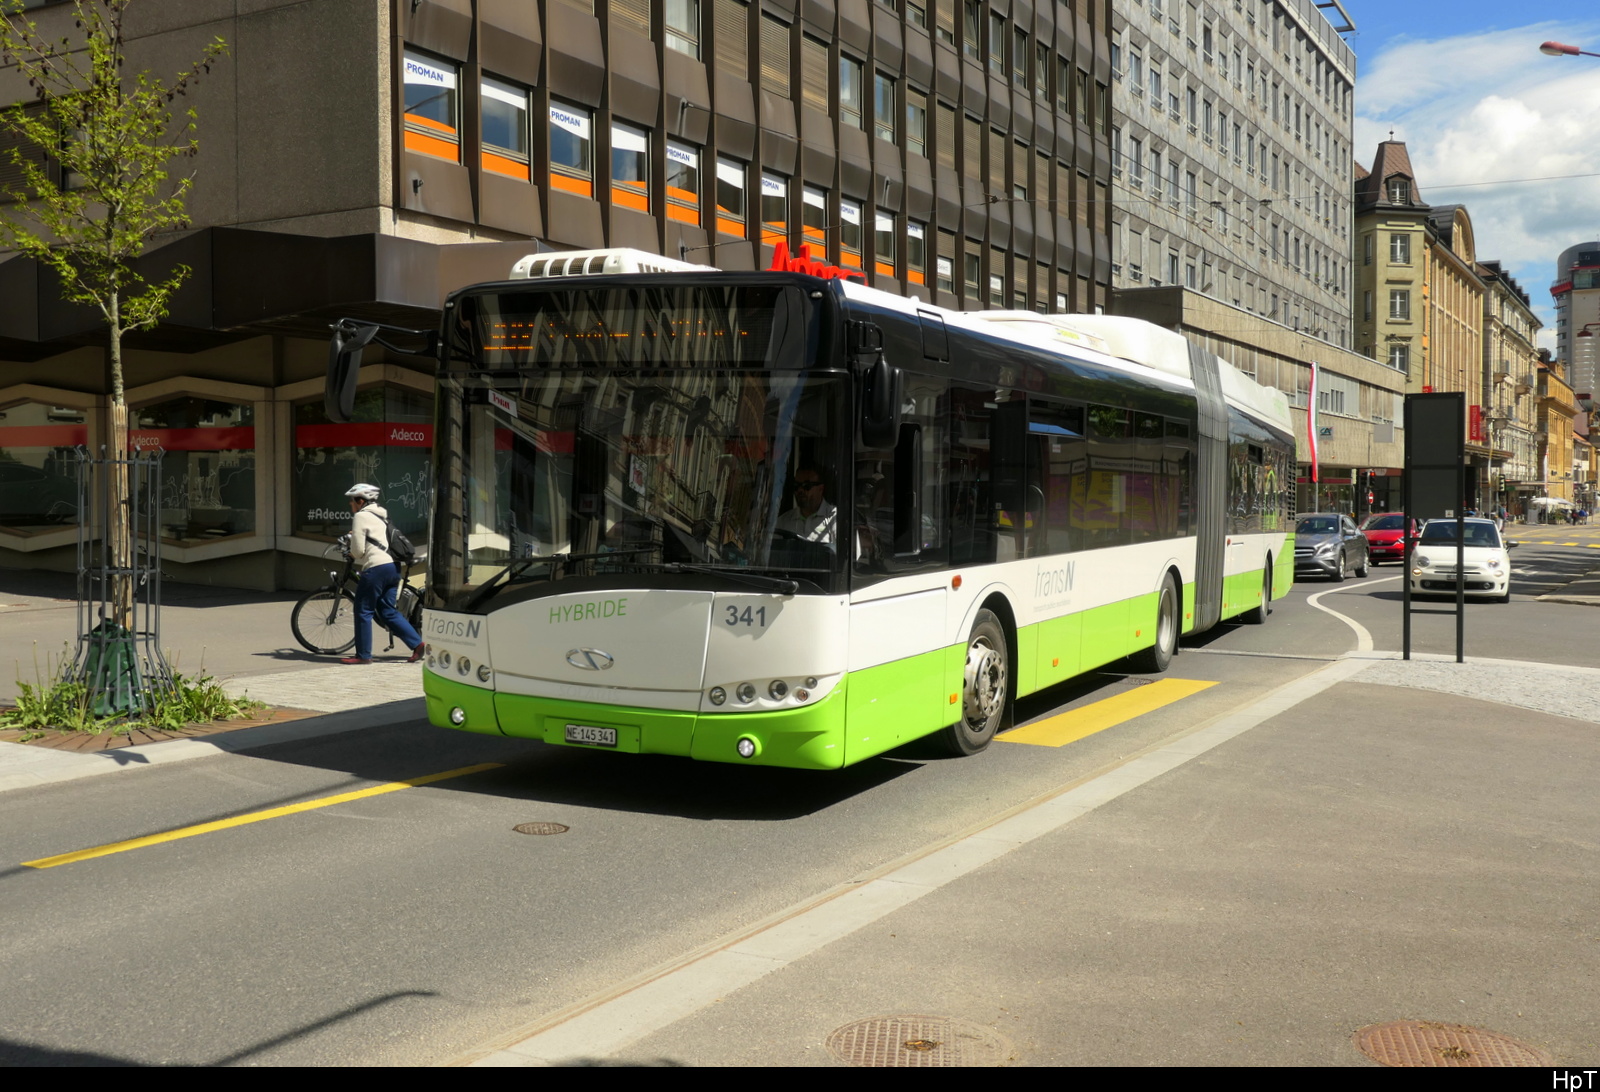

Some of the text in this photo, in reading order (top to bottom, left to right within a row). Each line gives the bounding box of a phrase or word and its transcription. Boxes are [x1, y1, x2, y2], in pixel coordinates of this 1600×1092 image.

[407, 62, 444, 82] PROMAN
[551, 111, 581, 127] PROMAN
[130, 436, 160, 446] Adecco
[390, 428, 425, 441] Adecco
[307, 508, 355, 520] #Adecco
[550, 598, 628, 624] HYBRIDE
[725, 605, 766, 627] 341
